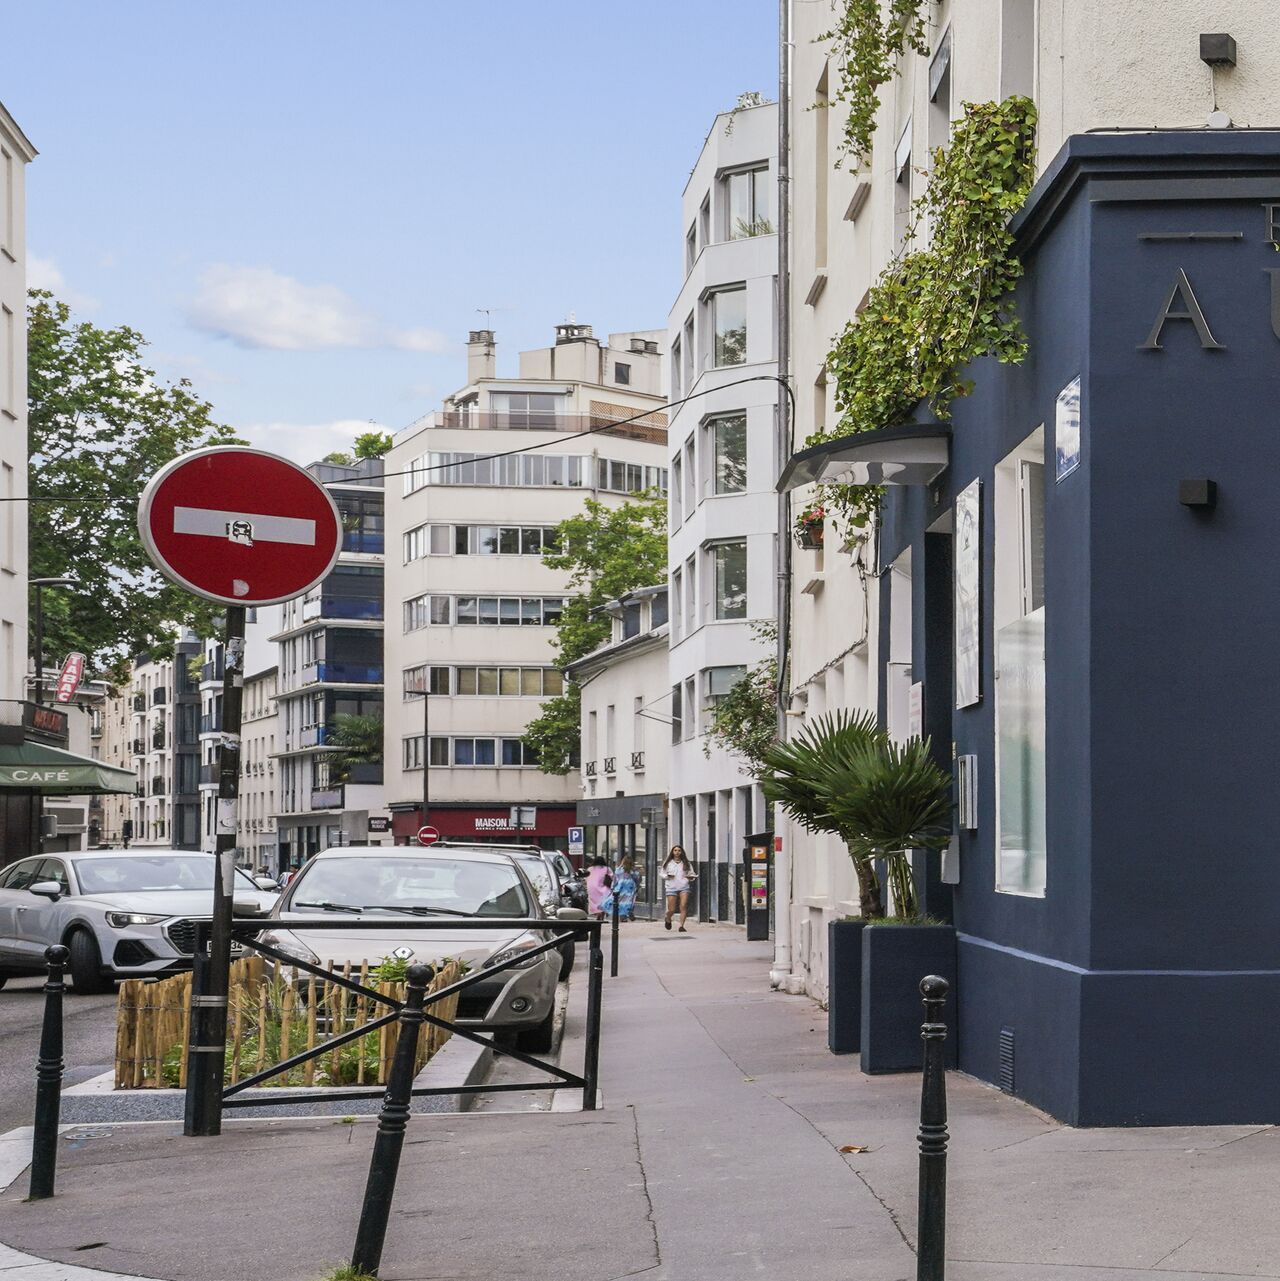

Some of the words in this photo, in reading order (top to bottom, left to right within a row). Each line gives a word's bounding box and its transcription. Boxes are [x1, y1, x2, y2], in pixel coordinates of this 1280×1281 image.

[58, 655, 82, 702] TABAC
[12, 770, 70, 781] CAFÉ
[475, 818, 507, 827] MAISON
[572, 831, 579, 841] P
